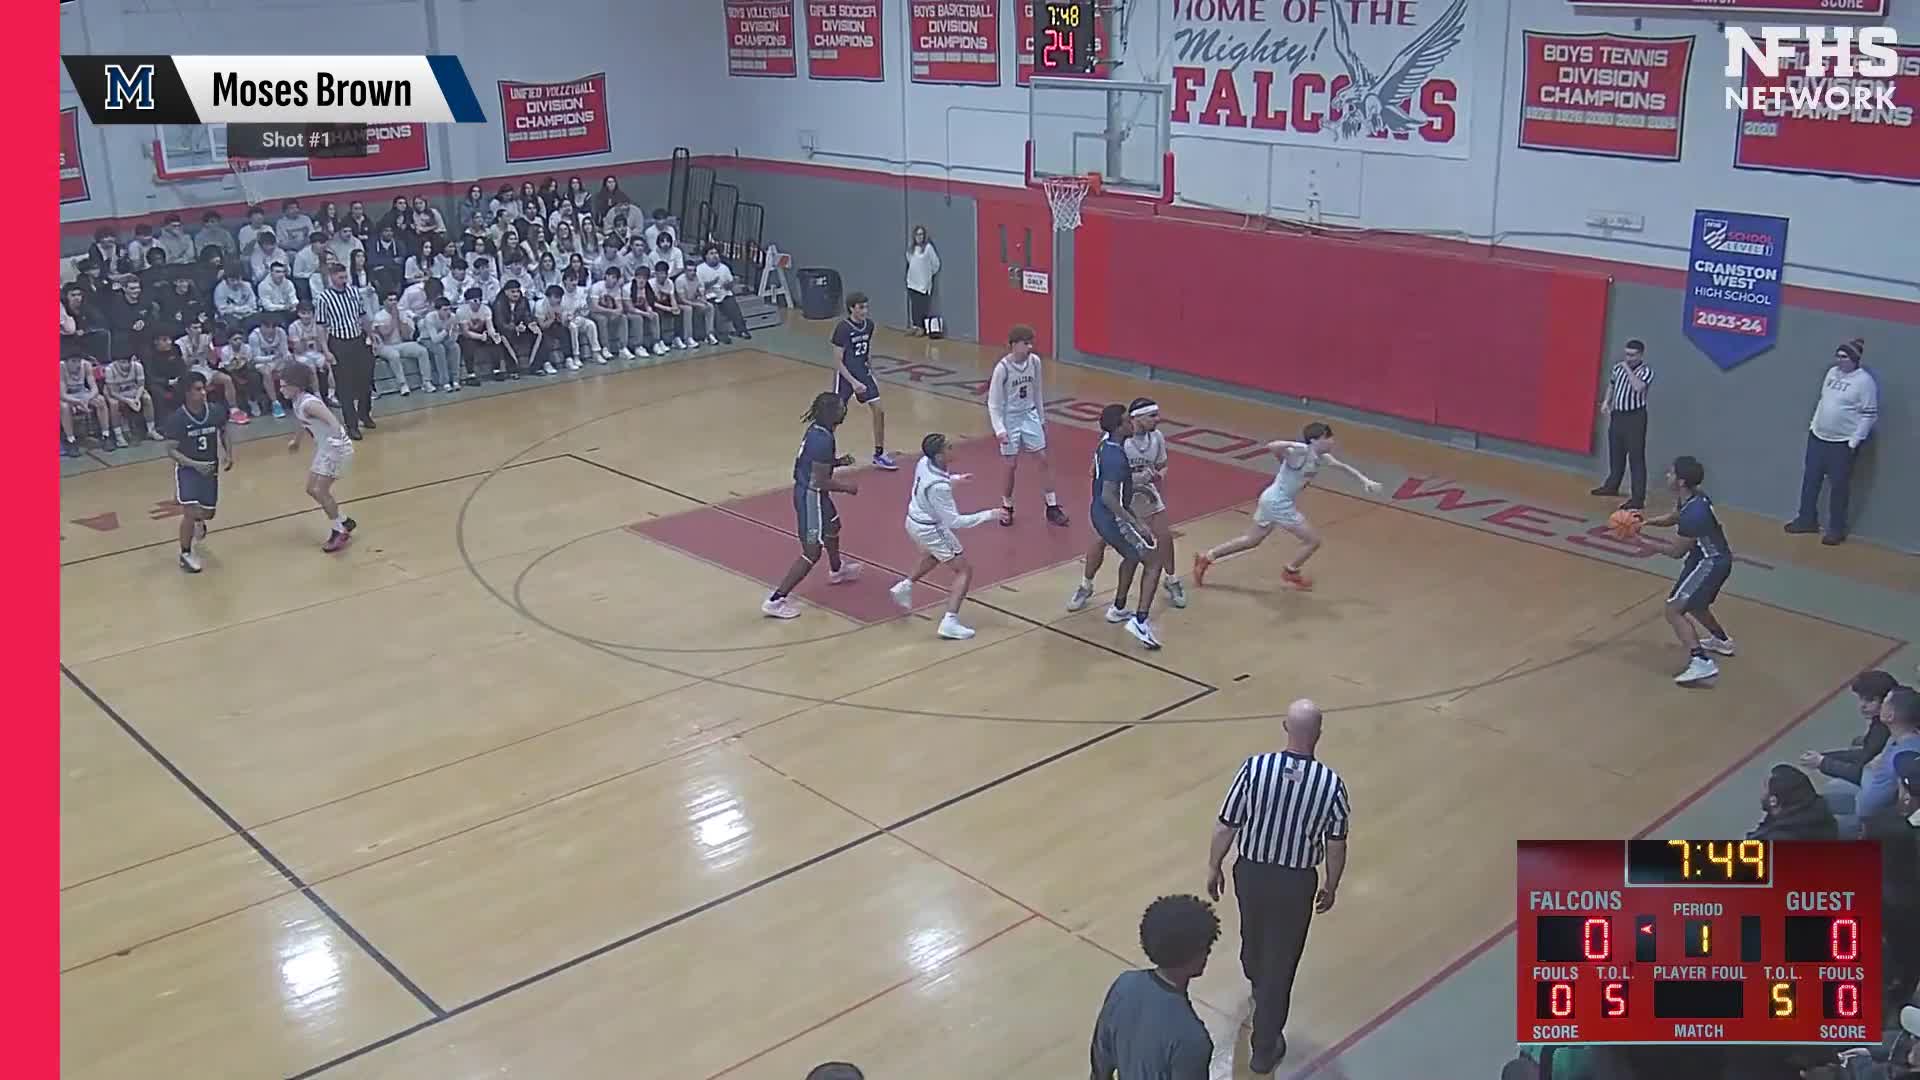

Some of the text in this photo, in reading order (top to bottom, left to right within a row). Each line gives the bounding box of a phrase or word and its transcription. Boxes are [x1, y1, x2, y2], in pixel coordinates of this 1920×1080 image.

[810, 4, 876, 18] GIRLS SOCCER
[914, 4, 993, 18] BOYS BASKETBALL
[1047, 5, 1080, 27] 7:48
[1173, 0, 1417, 26] HOME OF THE
[740, 20, 779, 33] DIVISION
[822, 19, 865, 33] DIVISION
[928, 20, 978, 34] DIVISION
[734, 34, 787, 47] CHAMPIONS
[814, 34, 874, 48] CHAMPIONS
[920, 36, 988, 50] CHAMPIONS
[1043, 29, 1074, 68] 24
[1174, 27, 1328, 73] Mighty!
[1543, 44, 1669, 67] BOYS TENNIS
[1558, 66, 1649, 88] DIVISION
[526, 97, 583, 113] DIVISION
[1540, 85, 1667, 110] CHAMPIONS
[515, 110, 595, 128] CHAMPIONS
[1695, 260, 1778, 280] CRANSTON
[1712, 274, 1757, 290] WEST
[1695, 286, 1772, 305] HIGH SCHOOL
[1696, 311, 1763, 333] 2023-24
[855, 342, 868, 356] 23
[198, 435, 208, 450] 3
[1392, 477, 1774, 570] WES
